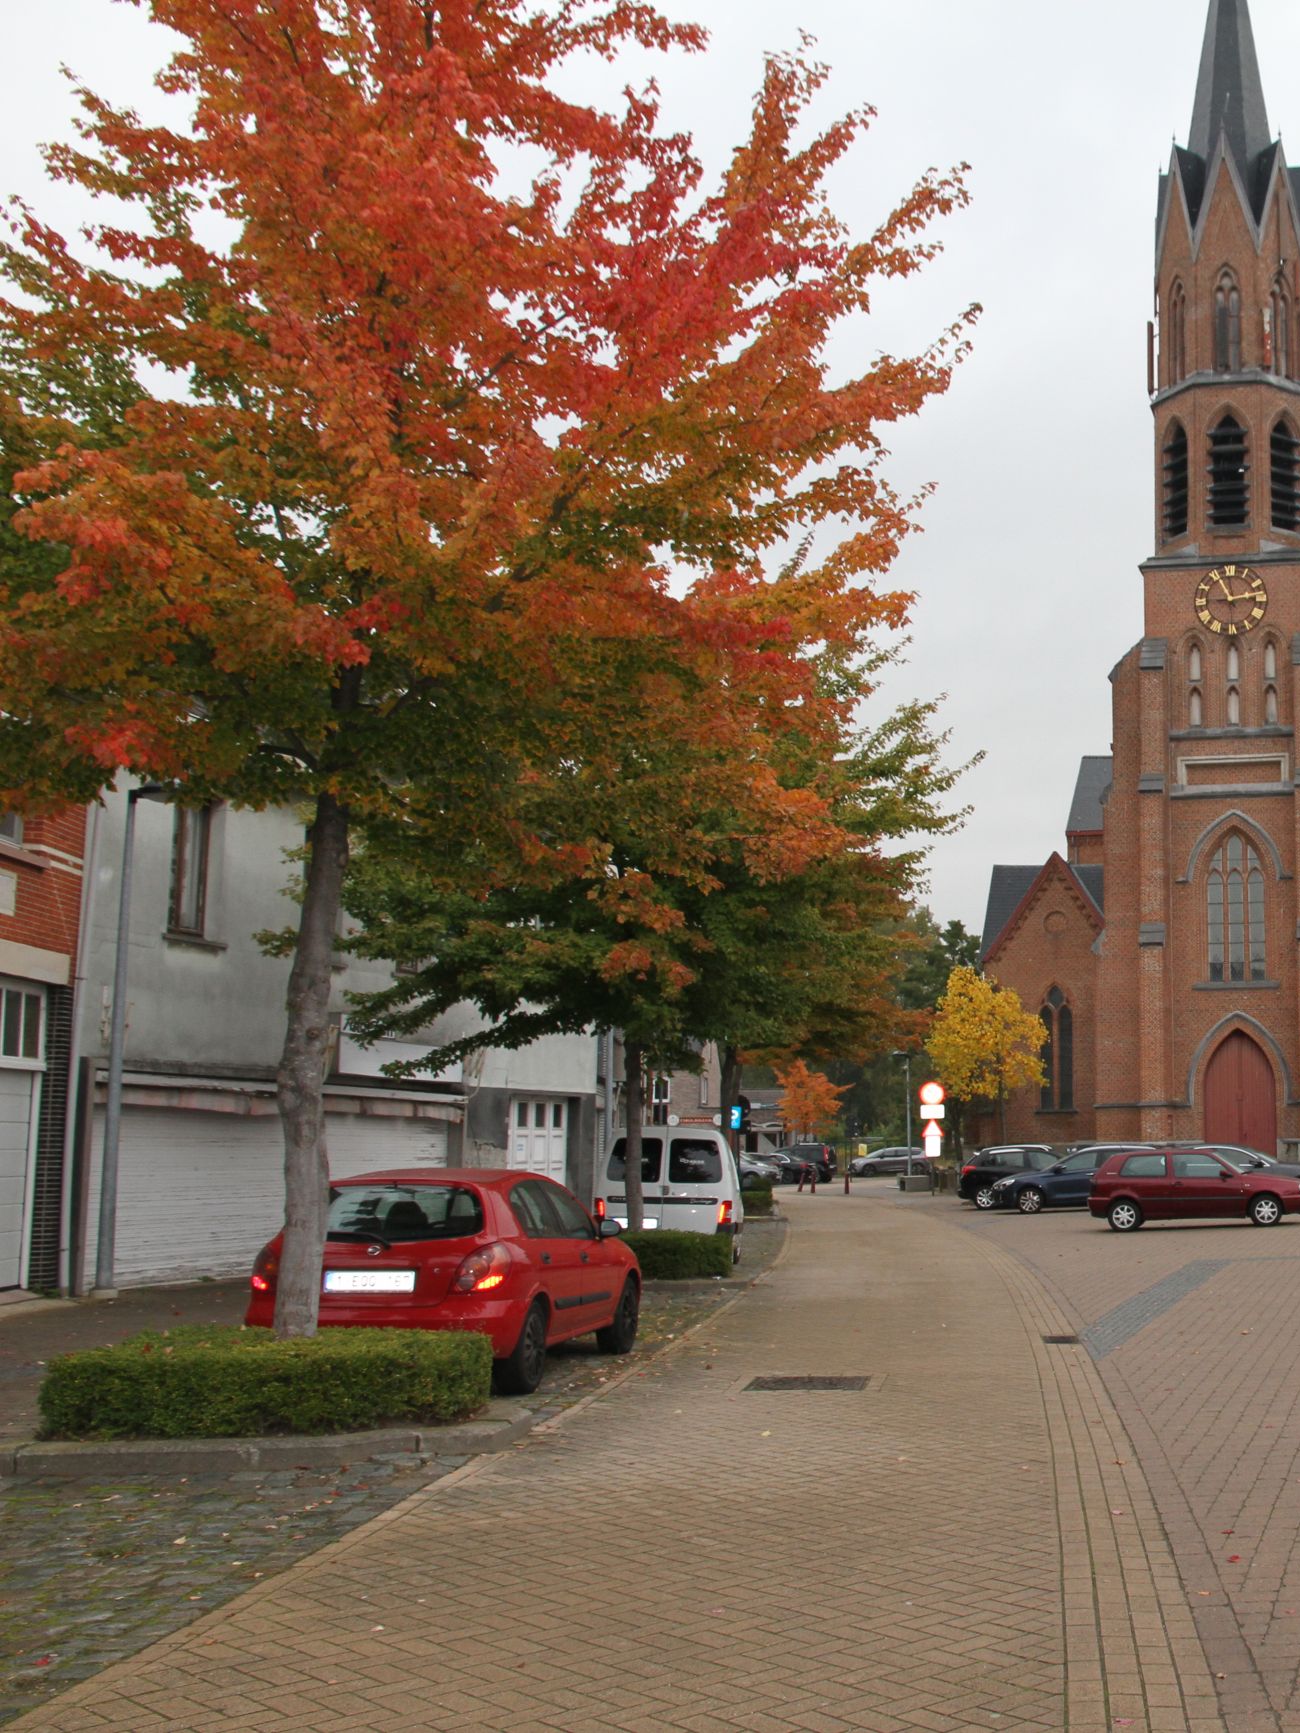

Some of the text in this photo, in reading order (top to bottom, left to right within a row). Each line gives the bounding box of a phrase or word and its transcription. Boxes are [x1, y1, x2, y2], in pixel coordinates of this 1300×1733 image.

[1208, 569, 1220, 581] XI
[1224, 565, 1235, 576] XII
[1242, 568, 1248, 578] I
[1199, 582, 1210, 591] X
[1195, 597, 1206, 606] IX
[1210, 620, 1221, 633] VII
[1228, 623, 1237, 634] VI
[1244, 620, 1253, 630] V
